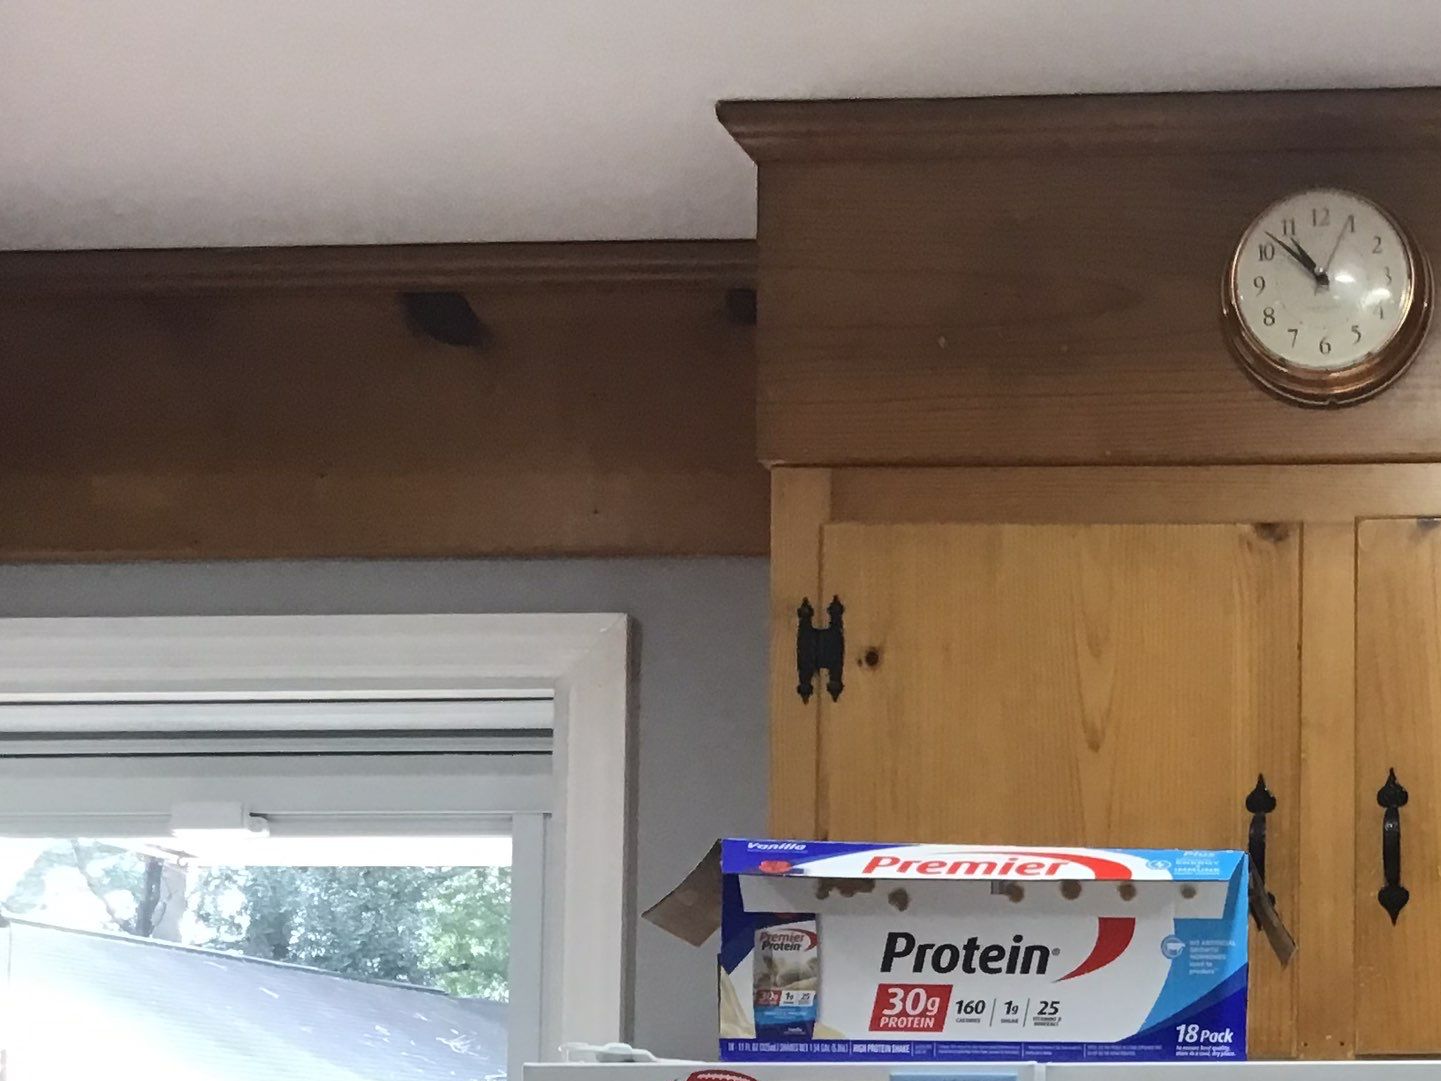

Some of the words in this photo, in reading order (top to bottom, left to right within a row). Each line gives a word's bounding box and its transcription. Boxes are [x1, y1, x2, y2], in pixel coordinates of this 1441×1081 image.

[1282, 217, 1296, 236] 11
[1311, 208, 1330, 227] 12
[1349, 215, 1355, 233] 1
[1258, 244, 1275, 262] 10
[1372, 236, 1382, 254] 2
[1384, 266, 1392, 285] 3
[1253, 276, 1266, 296] 9
[1263, 306, 1275, 327] 8
[1287, 328, 1298, 348] 7
[1351, 324, 1361, 344] 5
[1319, 336, 1331, 355] 6
[747, 842, 807, 851] Vanilla
[862, 856, 1069, 876] Premier
[760, 932, 805, 943] Premier
[761, 942, 802, 951] Protein
[880, 931, 1050, 974] Protein
[881, 988, 941, 1016] 30g
[955, 999, 986, 1015] 160
[1004, 1000, 1019, 1015] 1g
[1037, 1001, 1060, 1015] 25
[879, 1016, 934, 1028] PROTEIN
[1176, 1024, 1199, 1043] 18
[1200, 1028, 1233, 1043] Pack
[868, 1045, 891, 1053] PROTEIN
